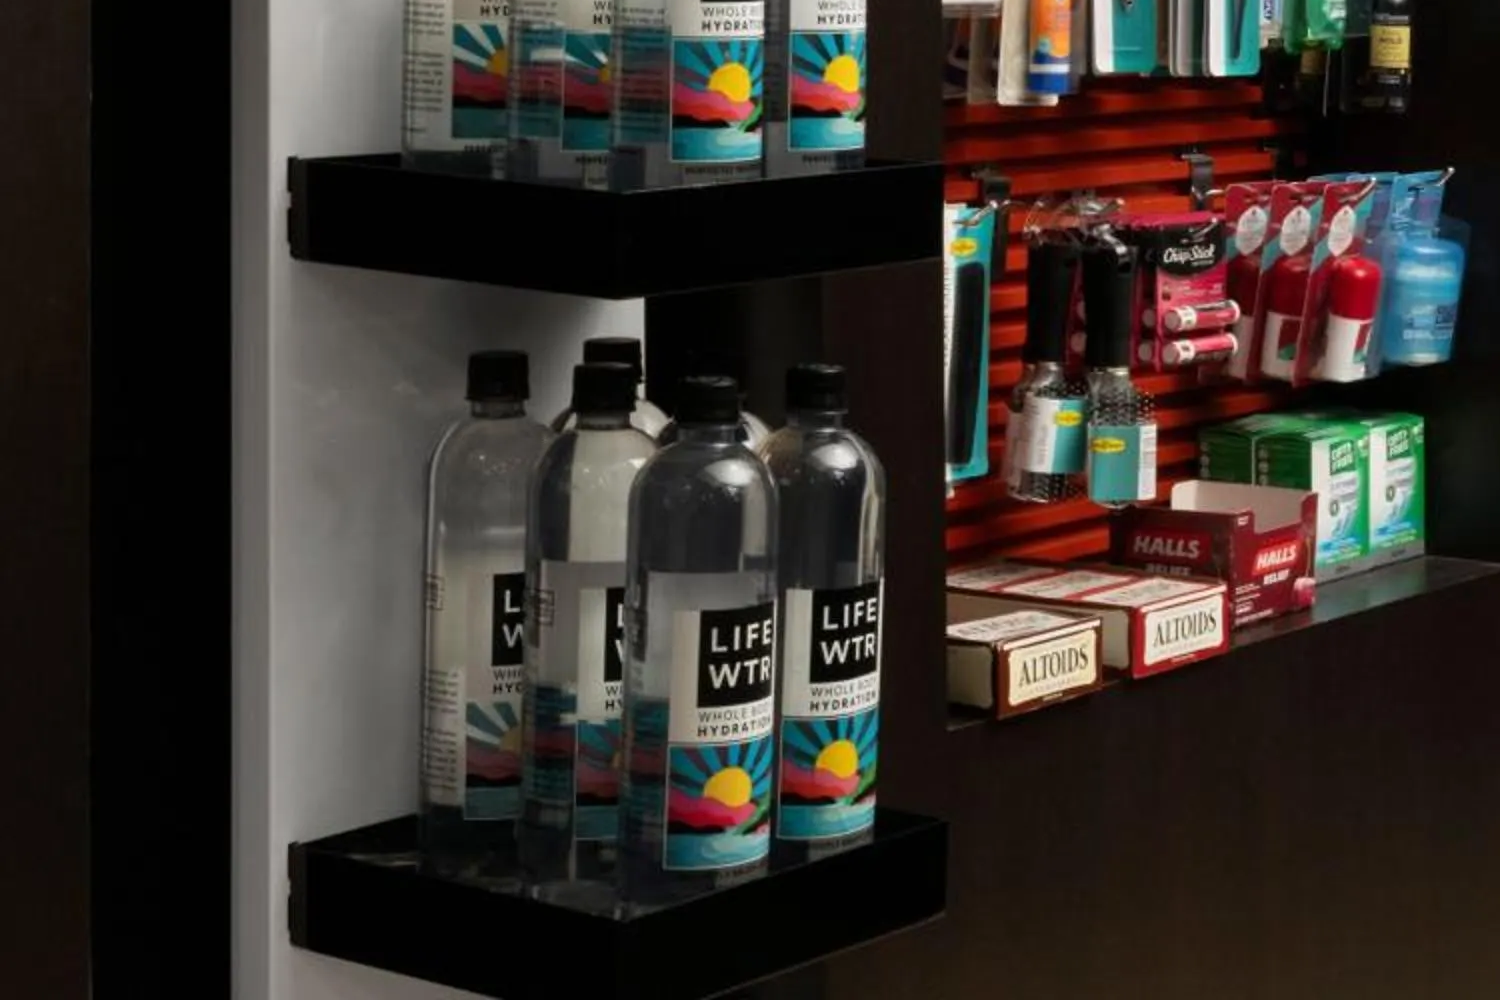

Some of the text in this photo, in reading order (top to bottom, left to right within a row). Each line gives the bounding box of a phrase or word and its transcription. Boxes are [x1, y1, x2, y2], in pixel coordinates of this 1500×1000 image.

[1163, 243, 1216, 264] ChapStick
[1134, 535, 1200, 559] HALLS
[1256, 545, 1297, 570] HALLS
[1263, 569, 1290, 586] RELIEF
[823, 598, 878, 631] LIFE
[711, 618, 772, 653] LIFE
[1153, 608, 1217, 648] ALTOIDS
[821, 633, 876, 665] WTR
[709, 656, 771, 689] WTR
[1018, 644, 1089, 688] ALTOIDS
[810, 691, 877, 711] HYDRATION
[811, 681, 856, 697] WHOLE
[699, 707, 747, 723] WHOLE
